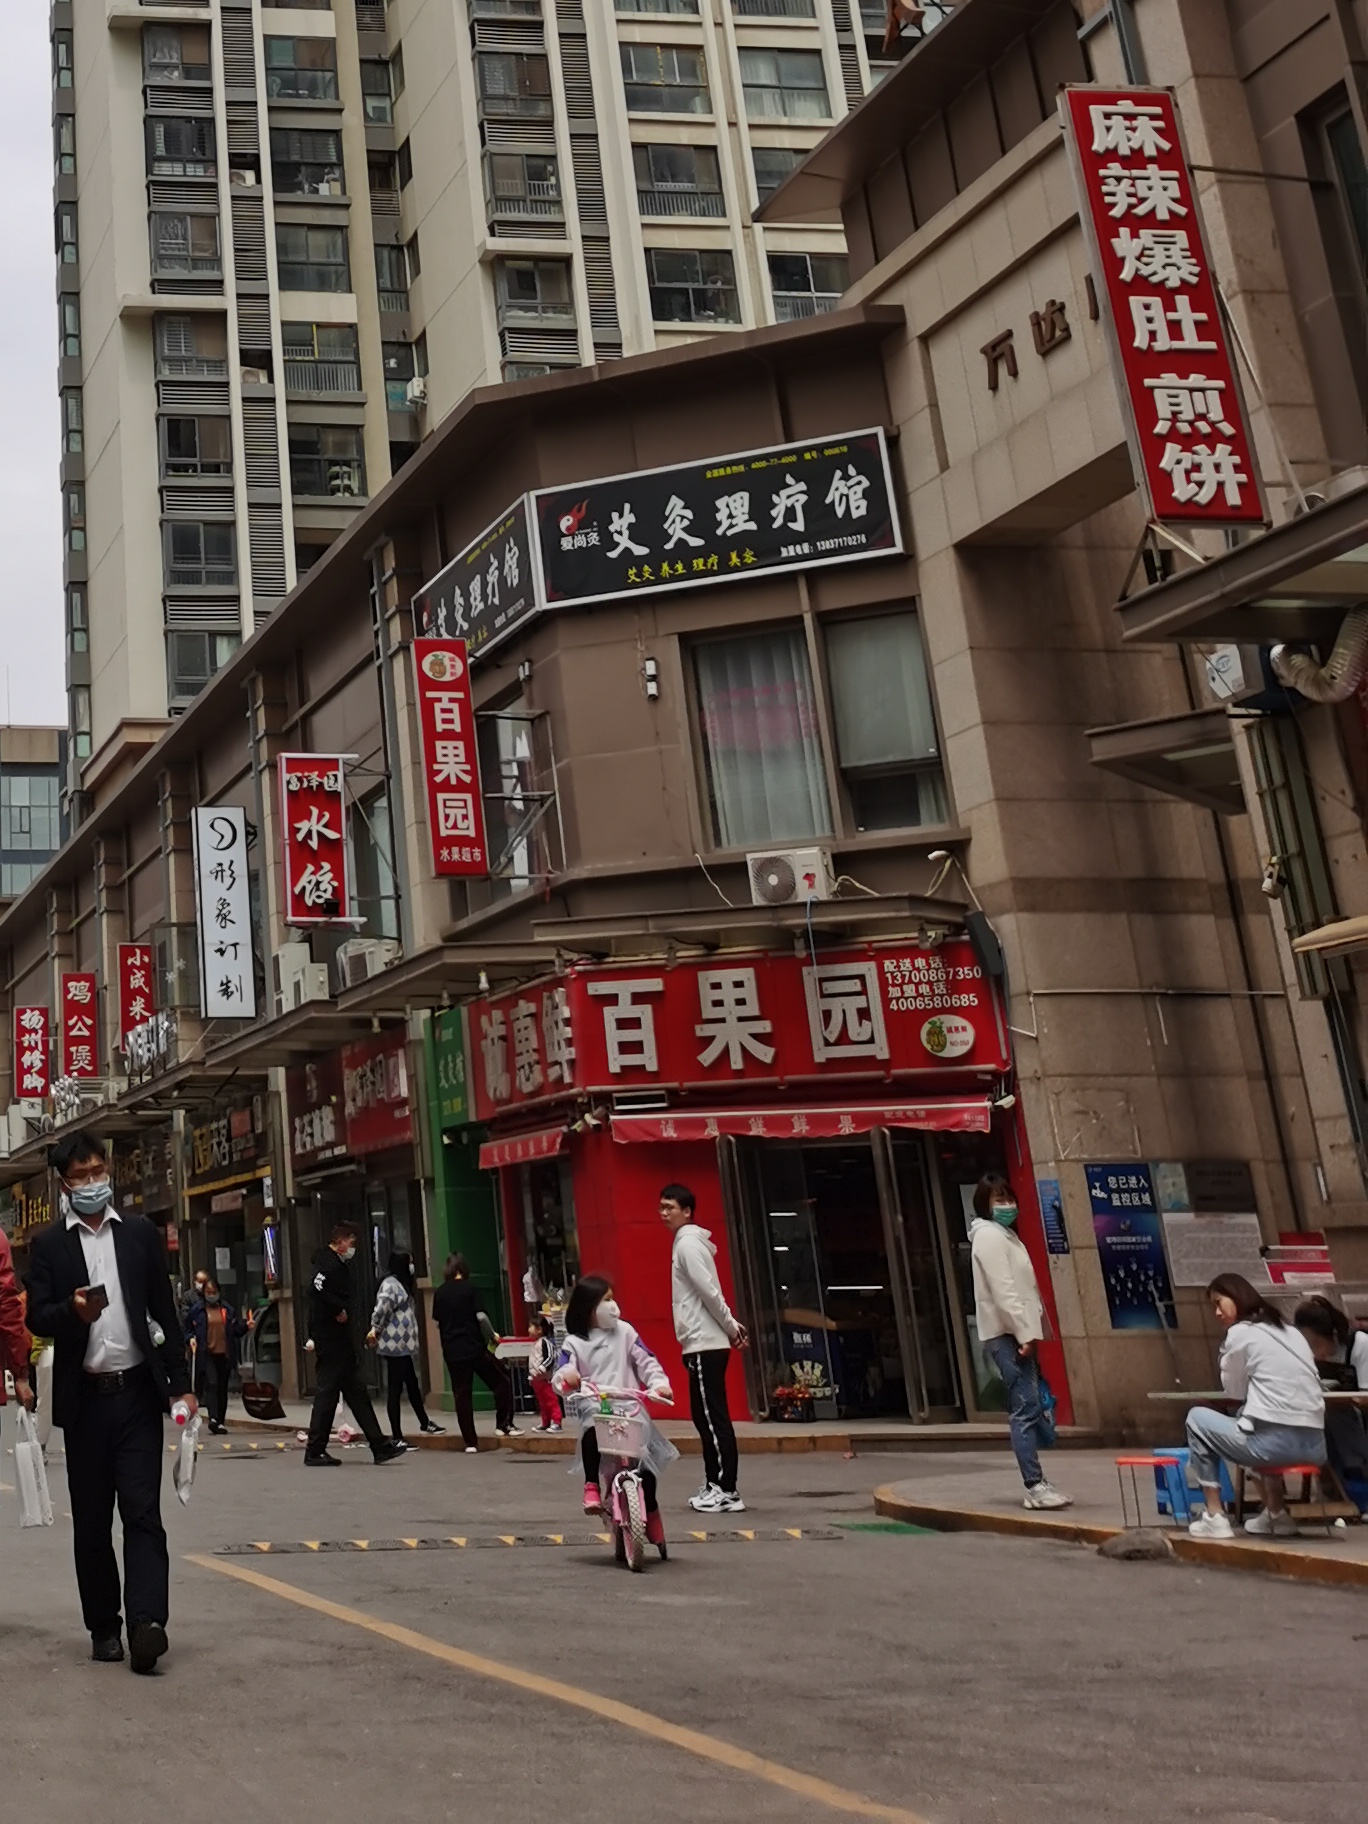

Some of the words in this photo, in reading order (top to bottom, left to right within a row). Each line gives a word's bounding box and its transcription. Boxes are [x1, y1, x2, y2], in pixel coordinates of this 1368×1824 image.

[979, 272, 1100, 392] 万达
[560, 531, 601, 552] 爱尚灸
[605, 463, 871, 559] 艾灸理疗馆
[626, 564, 655, 584] 艾灸
[659, 557, 688, 579] 养生
[692, 552, 720, 572] 理疗
[728, 547, 758, 568] 美容
[424, 690, 477, 839] 百果园
[292, 804, 342, 907] 水饺
[439, 846, 482, 863] 水果超市
[209, 859, 244, 1004] 形象订制
[885, 965, 982, 986] 13700867350
[66, 980, 94, 1072] 鸡公煲
[480, 986, 577, 1103] 诚惠鲜
[586, 961, 891, 1074] 百果园
[889, 993, 979, 1012] 4006580685
[19, 1008, 46, 1094] 扬州修脚
[1107, 1175, 1149, 1189] 您已进入
[1111, 1191, 1153, 1207] 监控区域
